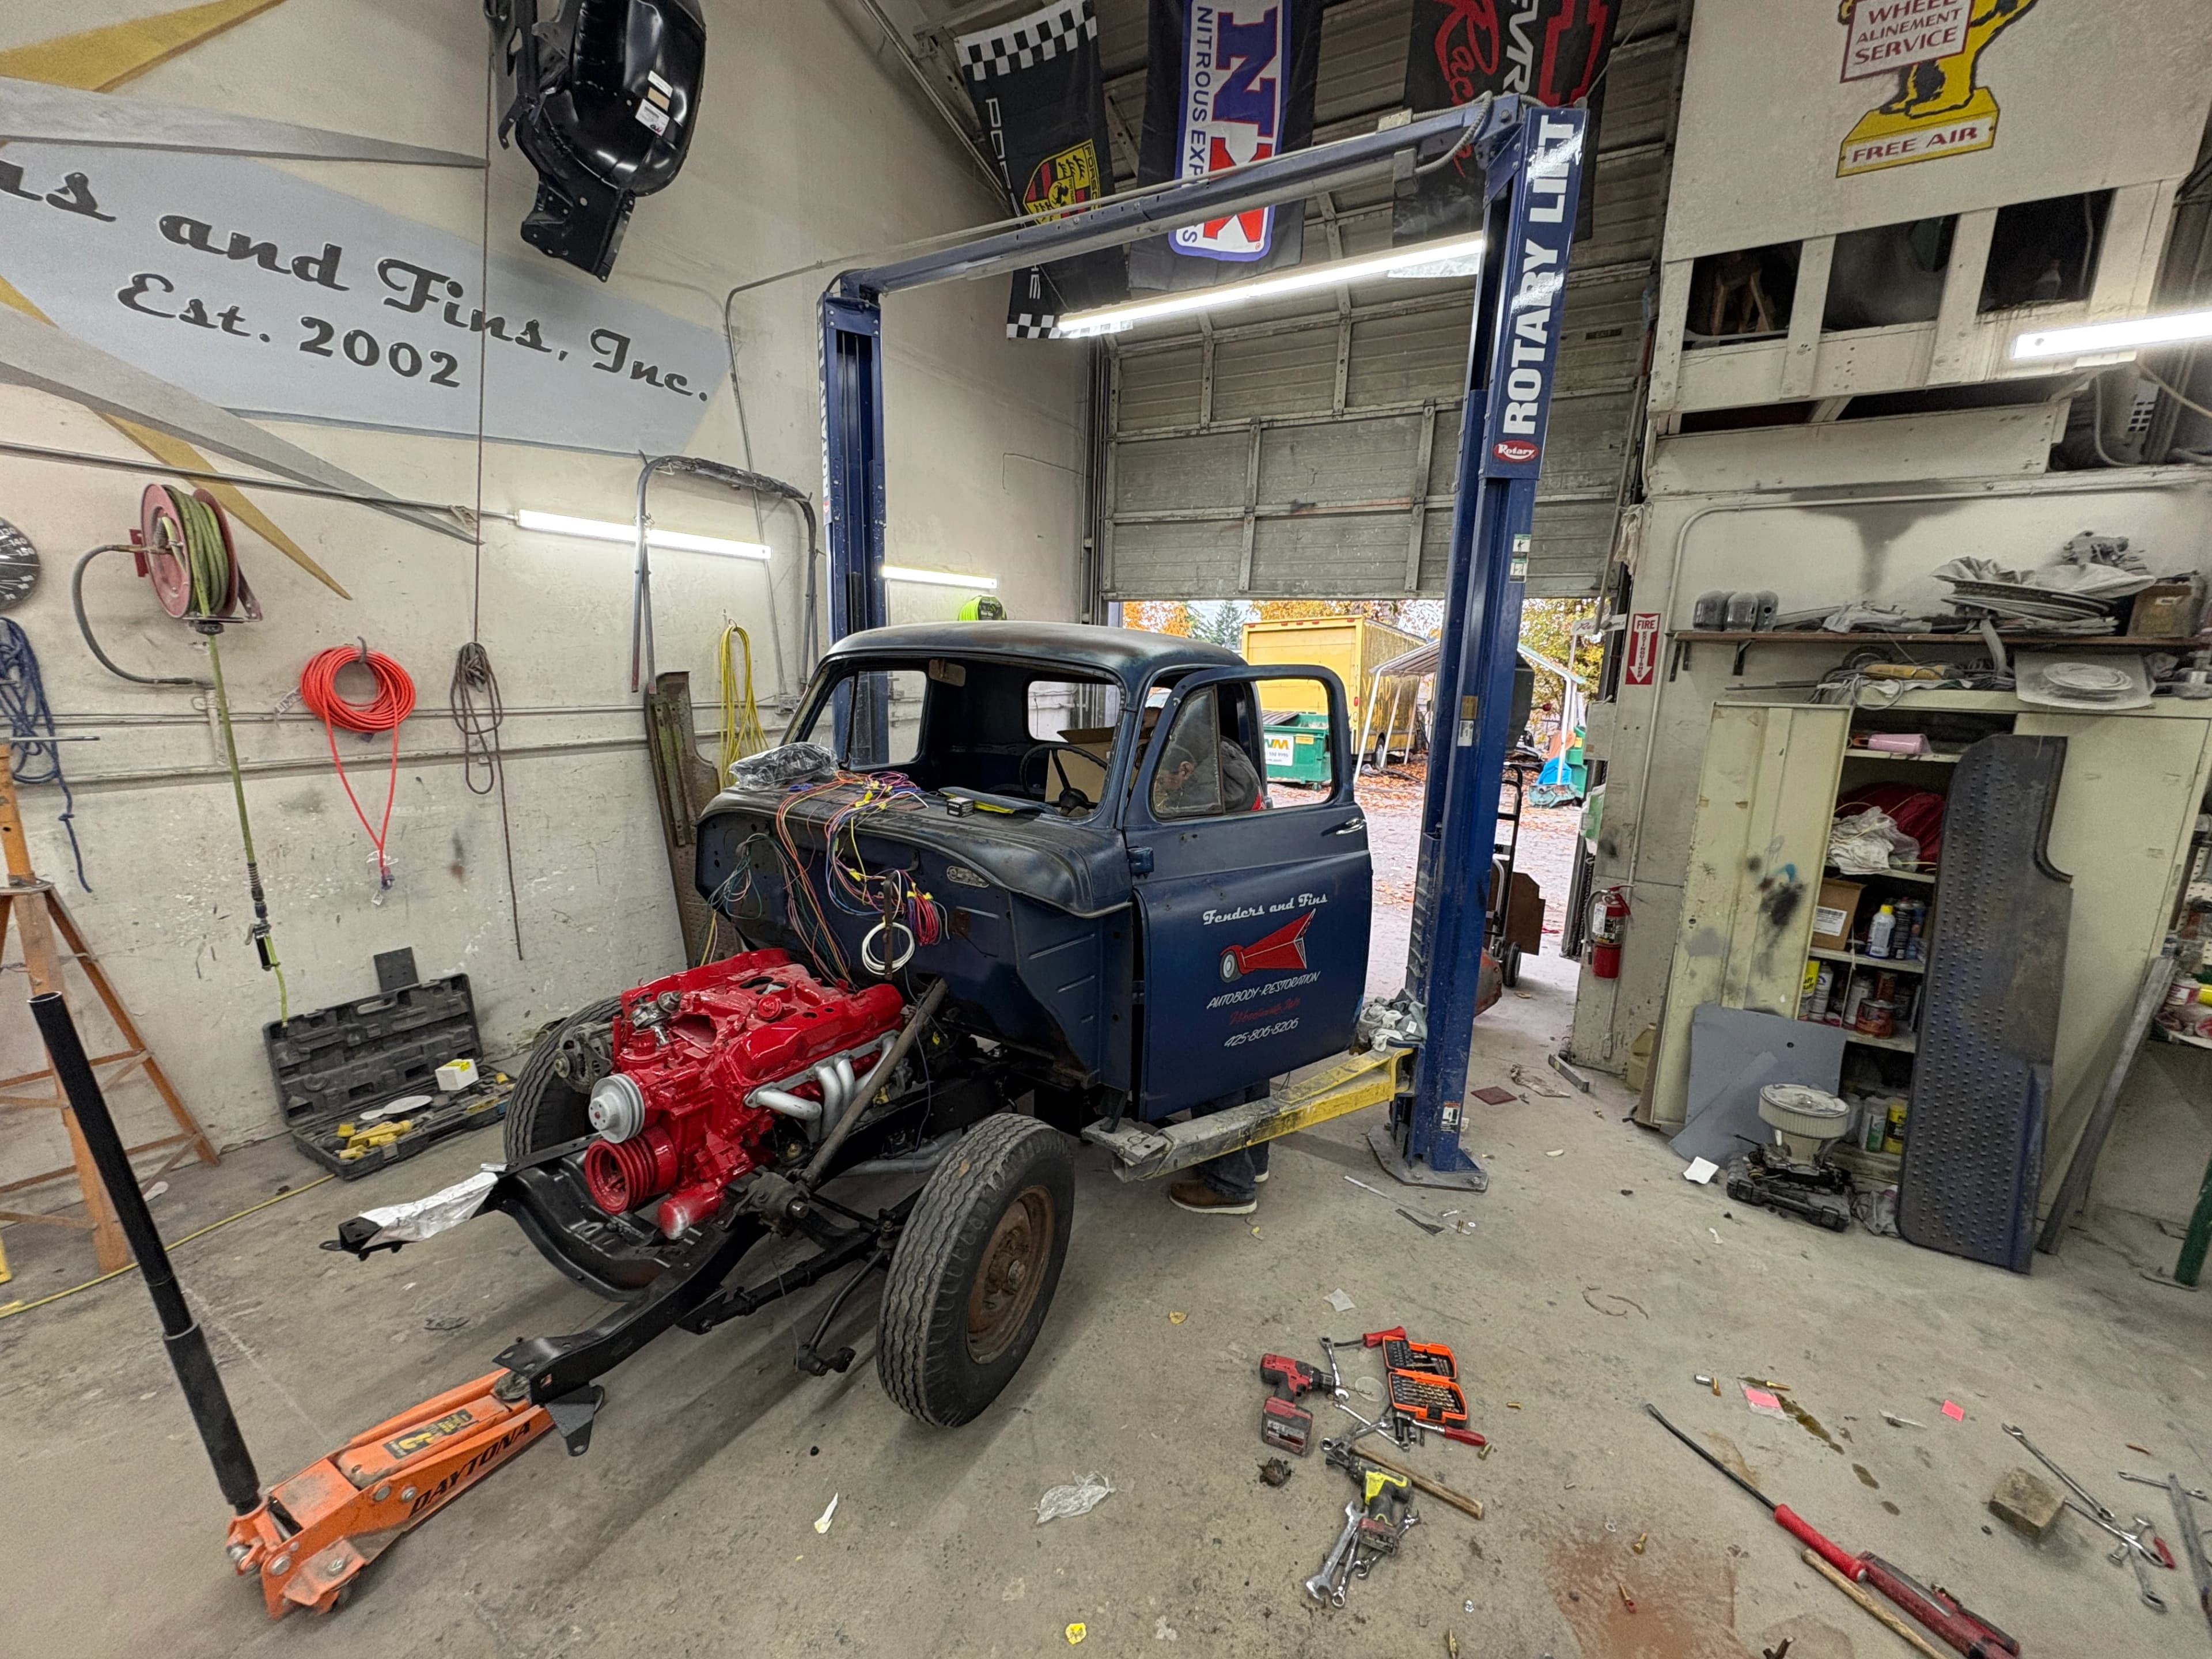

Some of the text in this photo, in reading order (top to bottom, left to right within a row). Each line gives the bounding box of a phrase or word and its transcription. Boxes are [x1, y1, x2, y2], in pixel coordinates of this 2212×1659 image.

[1853, 26, 1957, 65] SERVICE
[1856, 8, 1963, 44] ALINEMENT
[1192, 6, 1213, 122] NITROUS
[1852, 126, 1978, 163] FREE AIR
[158, 214, 350, 292] and
[377, 256, 569, 361] Fins,
[588, 328, 710, 402] Inc.
[117, 272, 461, 389] Est. 2002
[1503, 239, 1559, 435] ROTARY
[1498, 442, 1535, 460] Rotary
[1637, 620, 1656, 630] FIRE
[1203, 893, 1328, 925] Fenders and Fins
[408, 1421, 531, 1518] DAYTONA
